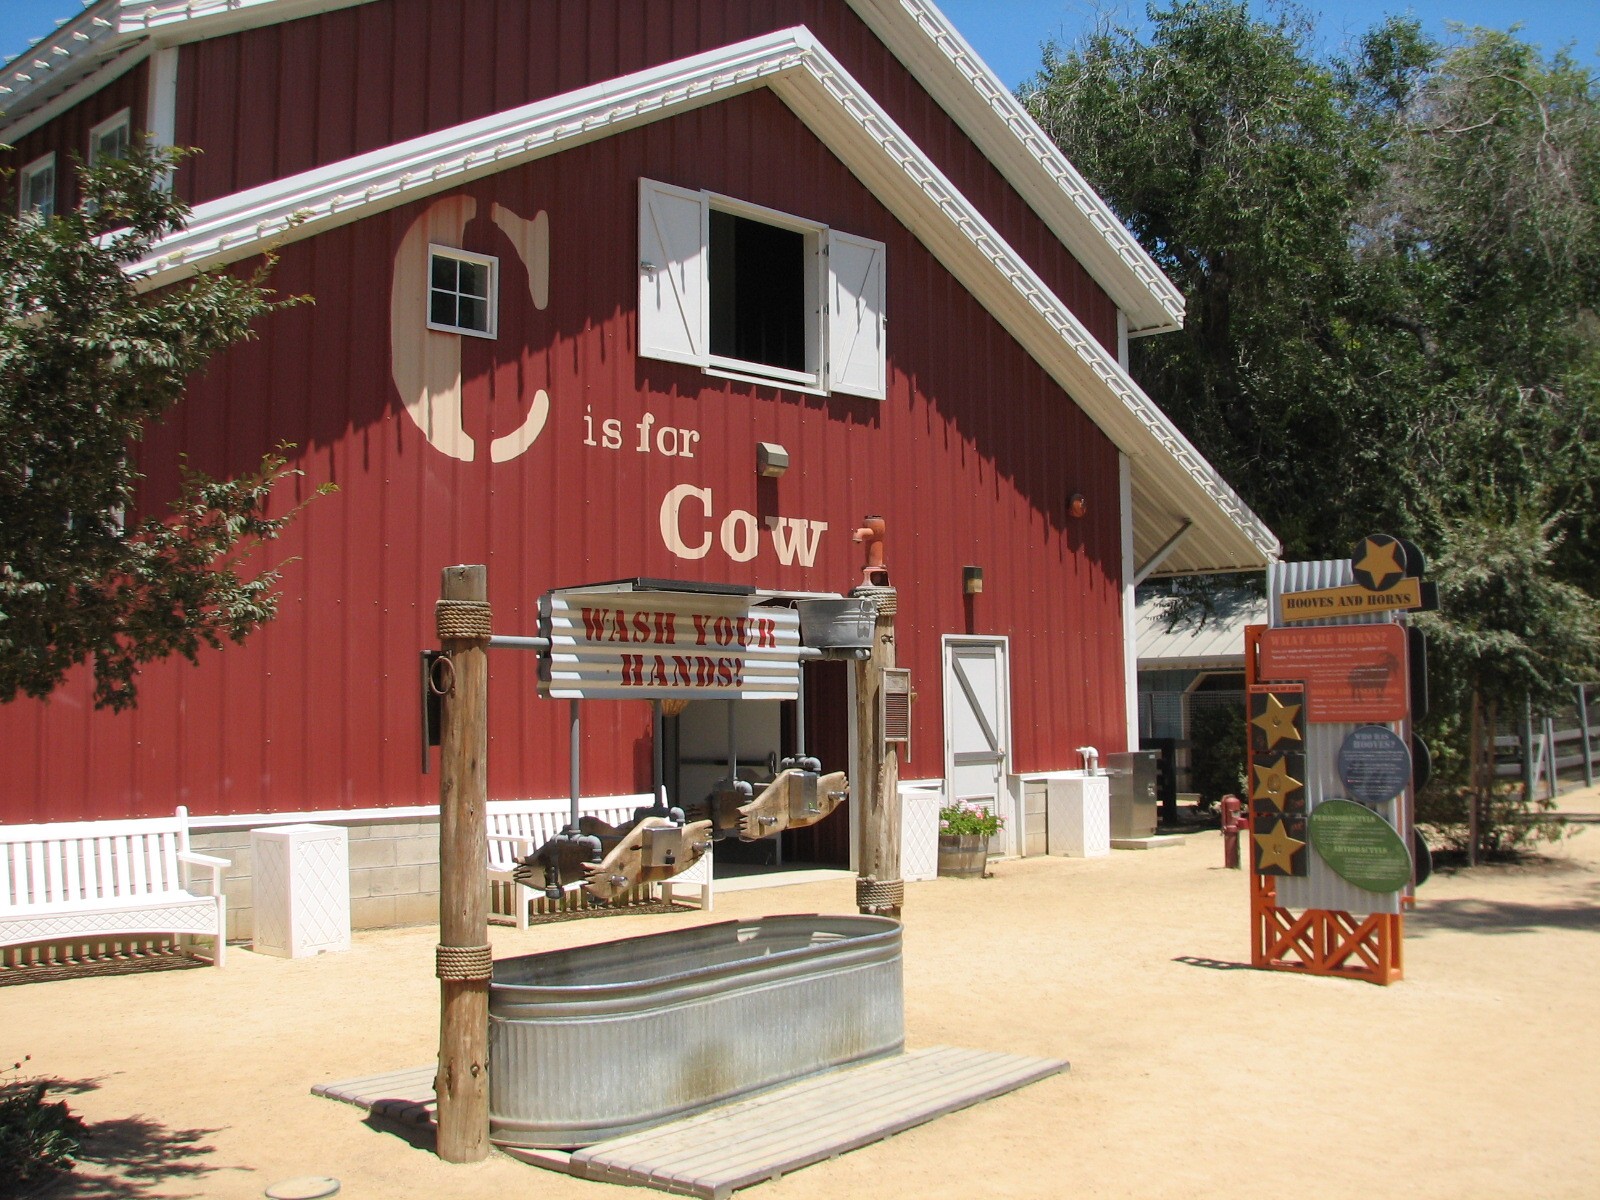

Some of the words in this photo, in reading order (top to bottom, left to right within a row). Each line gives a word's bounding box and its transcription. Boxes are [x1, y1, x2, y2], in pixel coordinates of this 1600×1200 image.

[391, 193, 550, 464] C
[582, 404, 623, 450] is
[636, 411, 701, 459] for
[659, 483, 829, 568] Cow
[1287, 597, 1334, 610] HOOVES
[1337, 595, 1363, 607] AND
[1367, 593, 1412, 606] HORNS
[580, 606, 677, 645] WASH
[691, 614, 777, 649] YOUR
[1270, 634, 1307, 646] WHAT
[1310, 633, 1335, 645] ARE
[1337, 631, 1388, 644] HORNS?
[620, 653, 744, 688] HANDS!
[1353, 740, 1396, 749] HOOVES?
